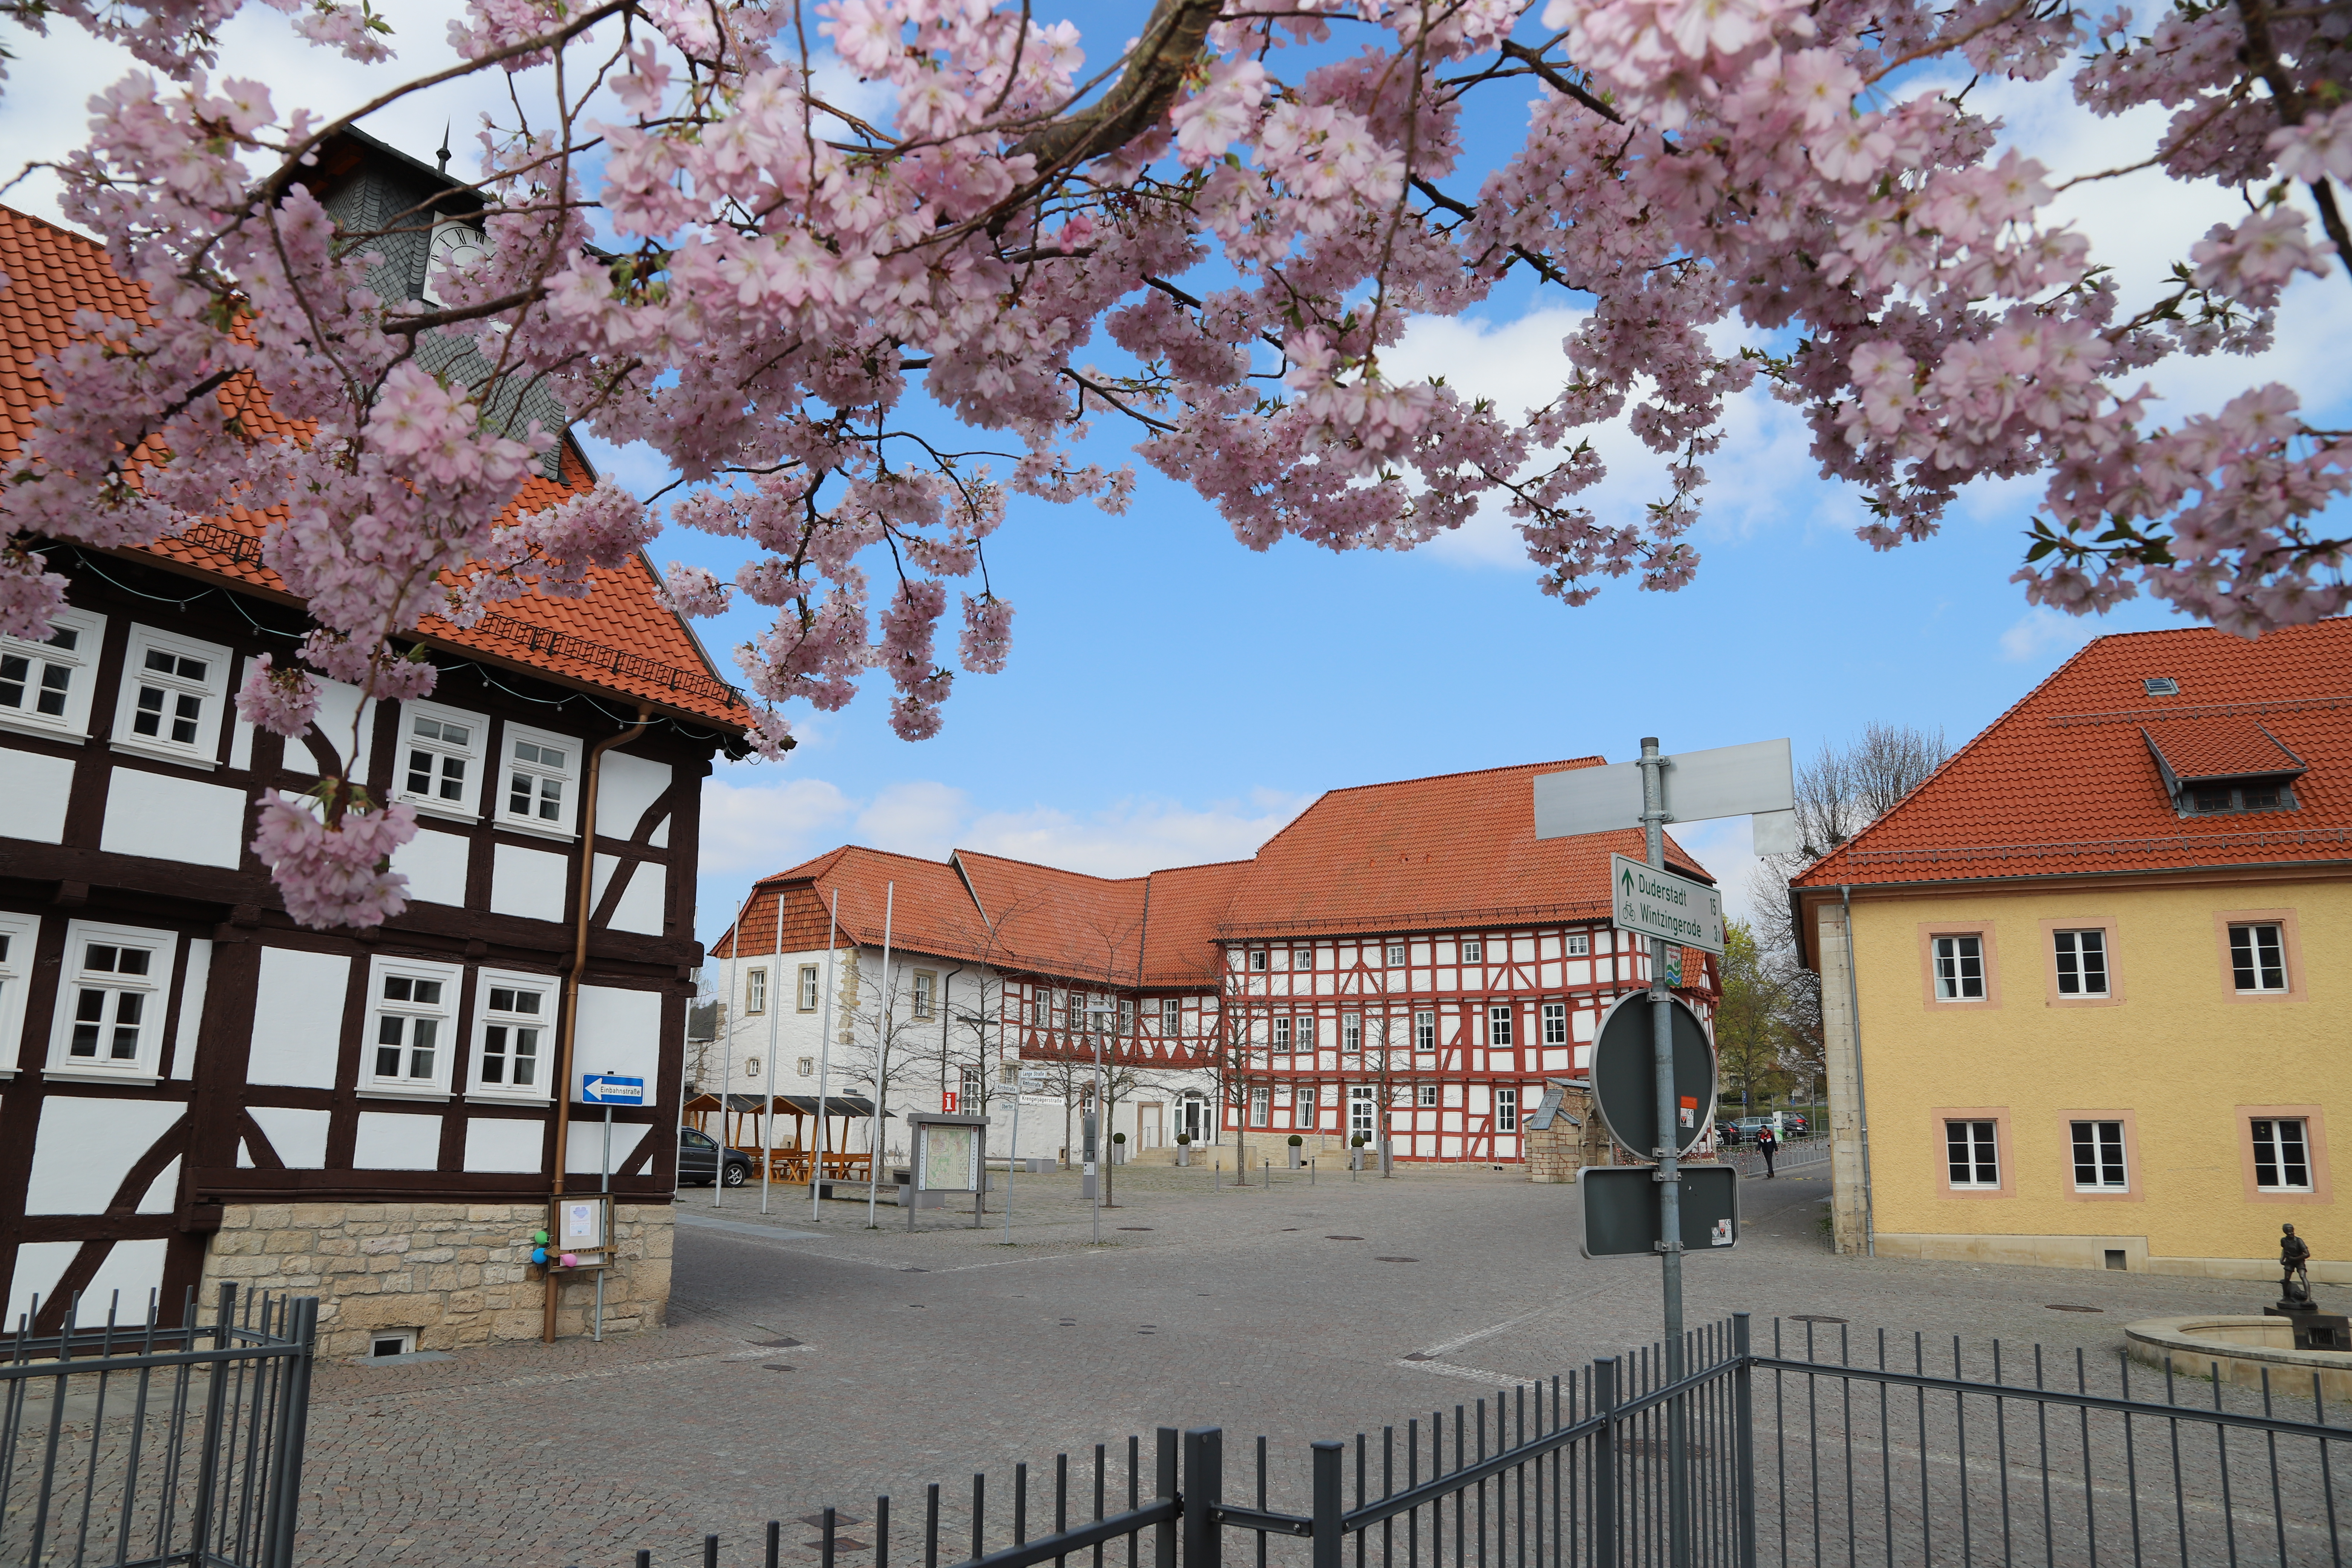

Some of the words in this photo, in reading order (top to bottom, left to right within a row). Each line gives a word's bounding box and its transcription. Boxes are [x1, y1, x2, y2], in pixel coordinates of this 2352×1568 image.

[438, 235, 453, 249] X
[455, 229, 467, 245] XI
[1639, 873, 1687, 907] Duderstadt
[1709, 898, 1717, 916] 15
[1640, 902, 1701, 938] Wintzingerode
[600, 1086, 640, 1095] Einbahnstraße
